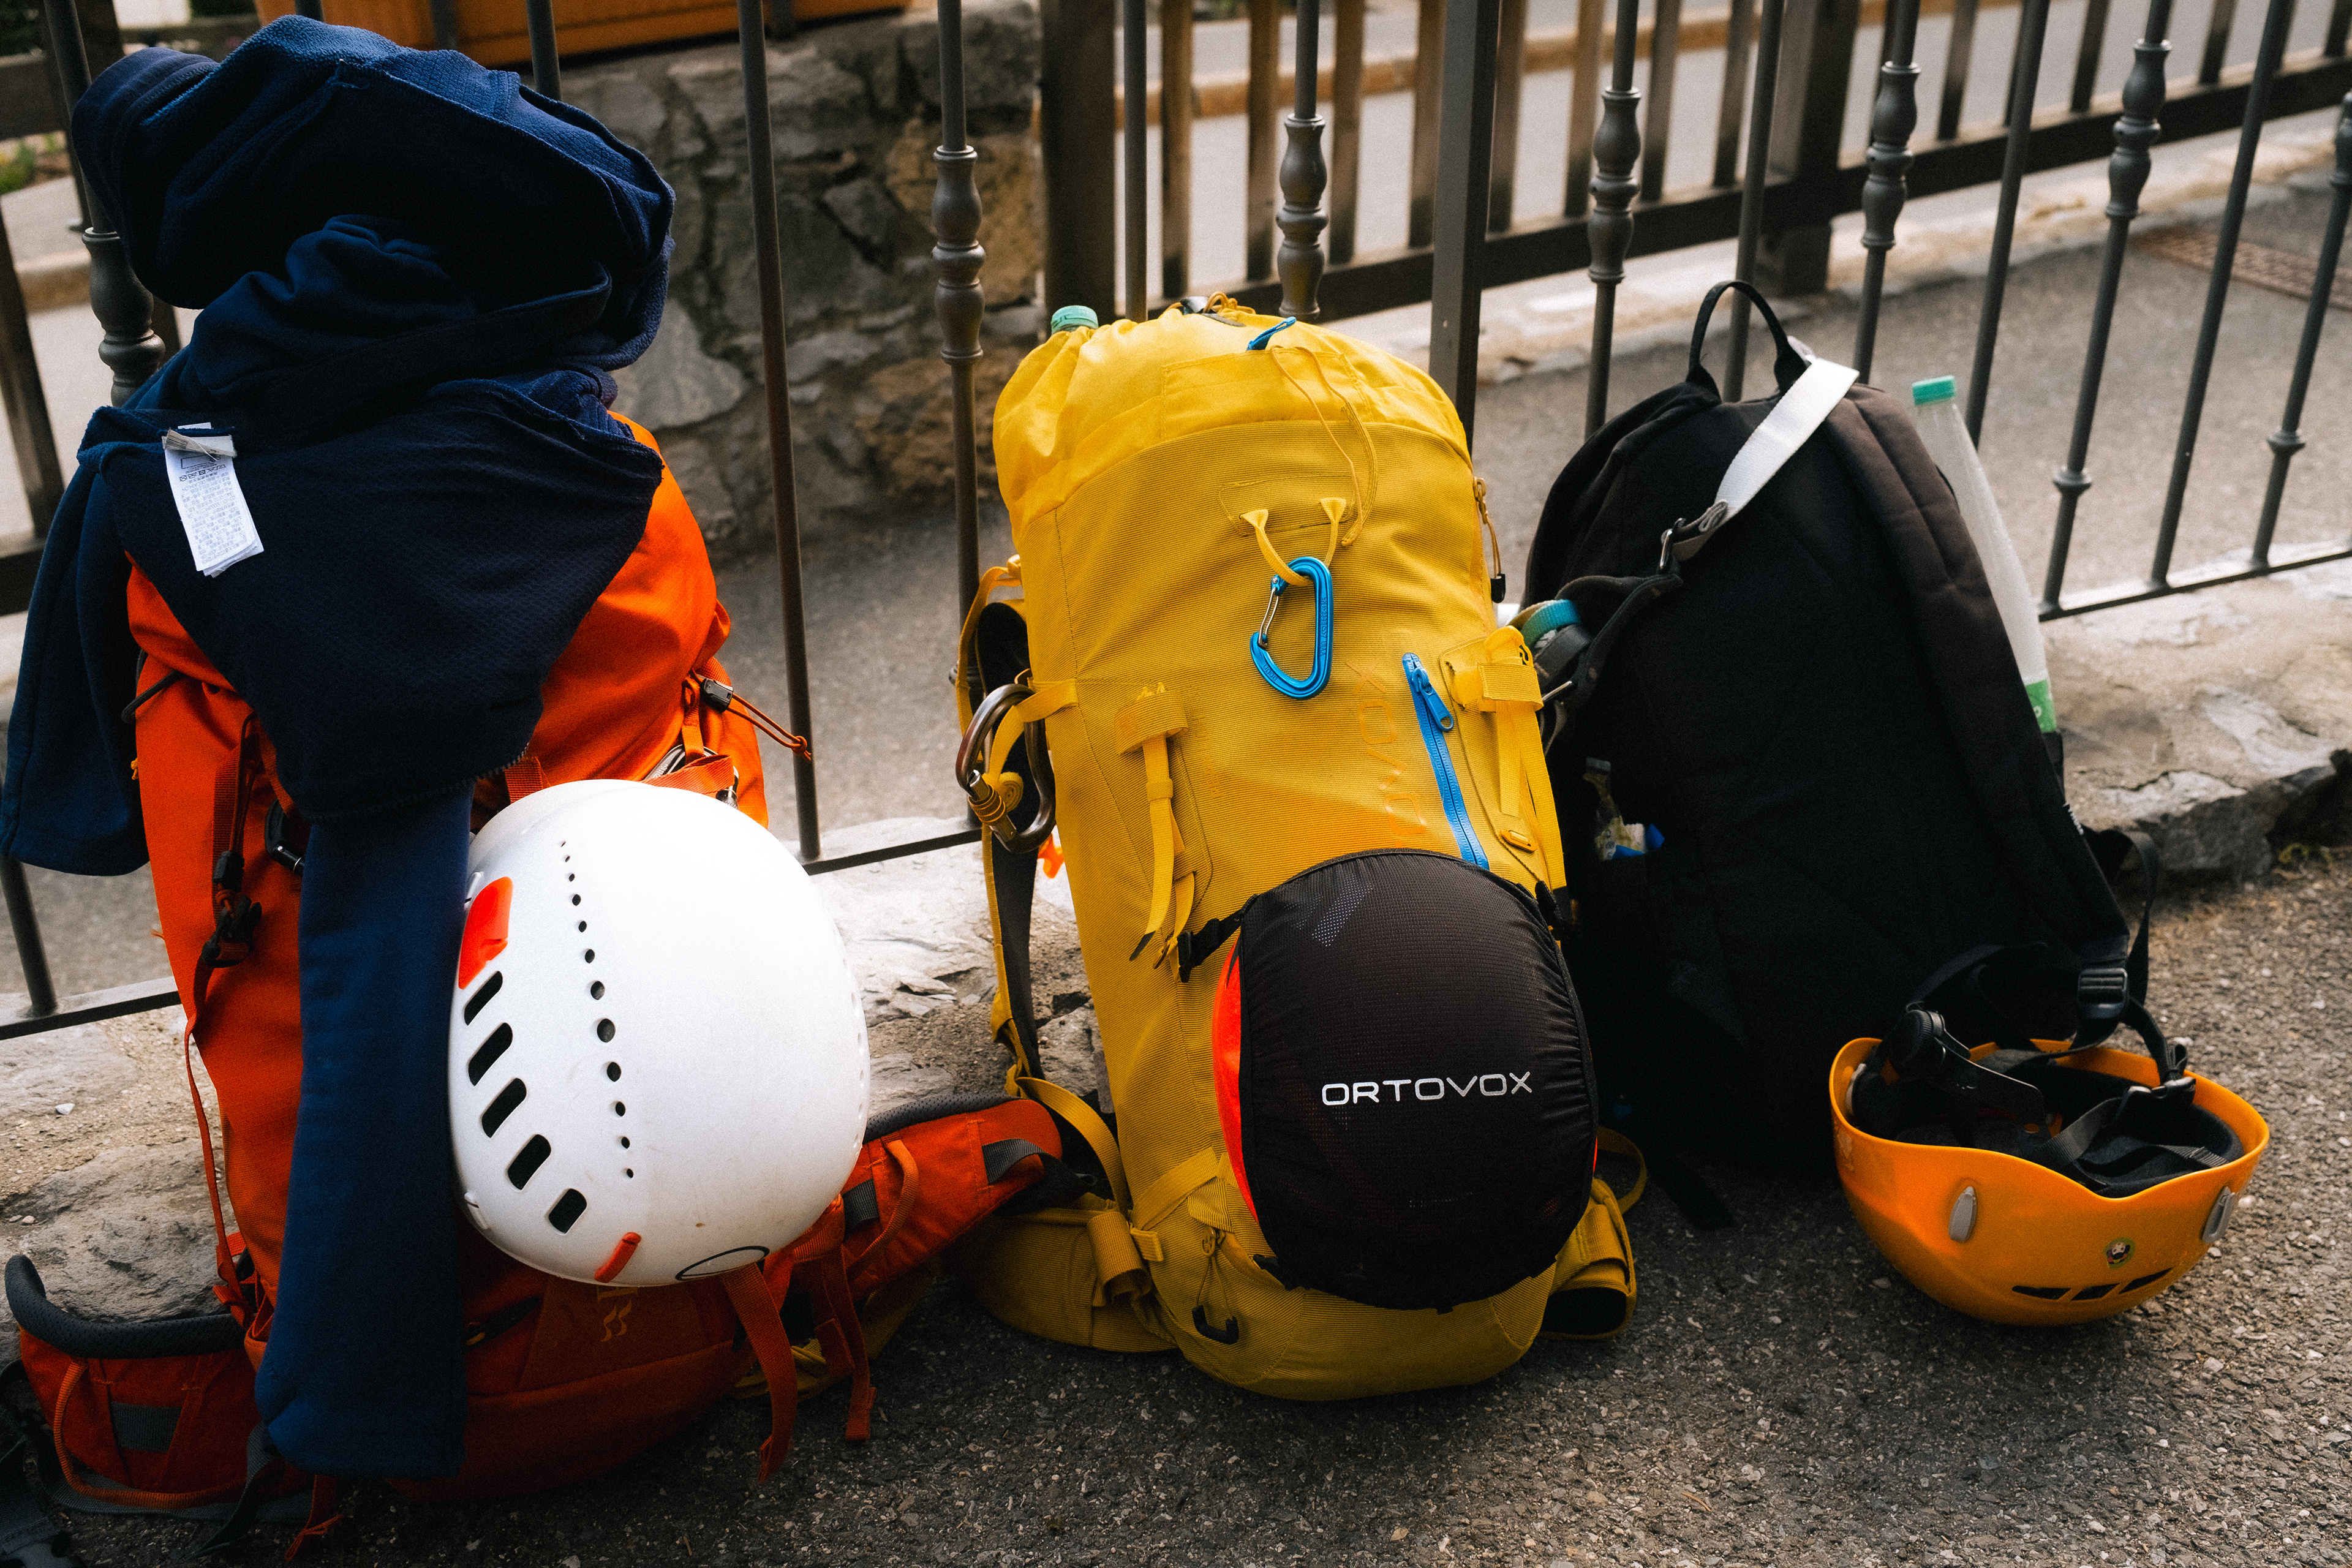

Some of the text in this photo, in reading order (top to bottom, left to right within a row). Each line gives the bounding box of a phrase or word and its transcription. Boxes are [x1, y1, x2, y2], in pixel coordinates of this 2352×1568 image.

[1344, 658, 1427, 848] OVOX
[1199, 754, 1224, 799] PEAK
[1321, 1071, 1532, 1106] ORTOVOX
